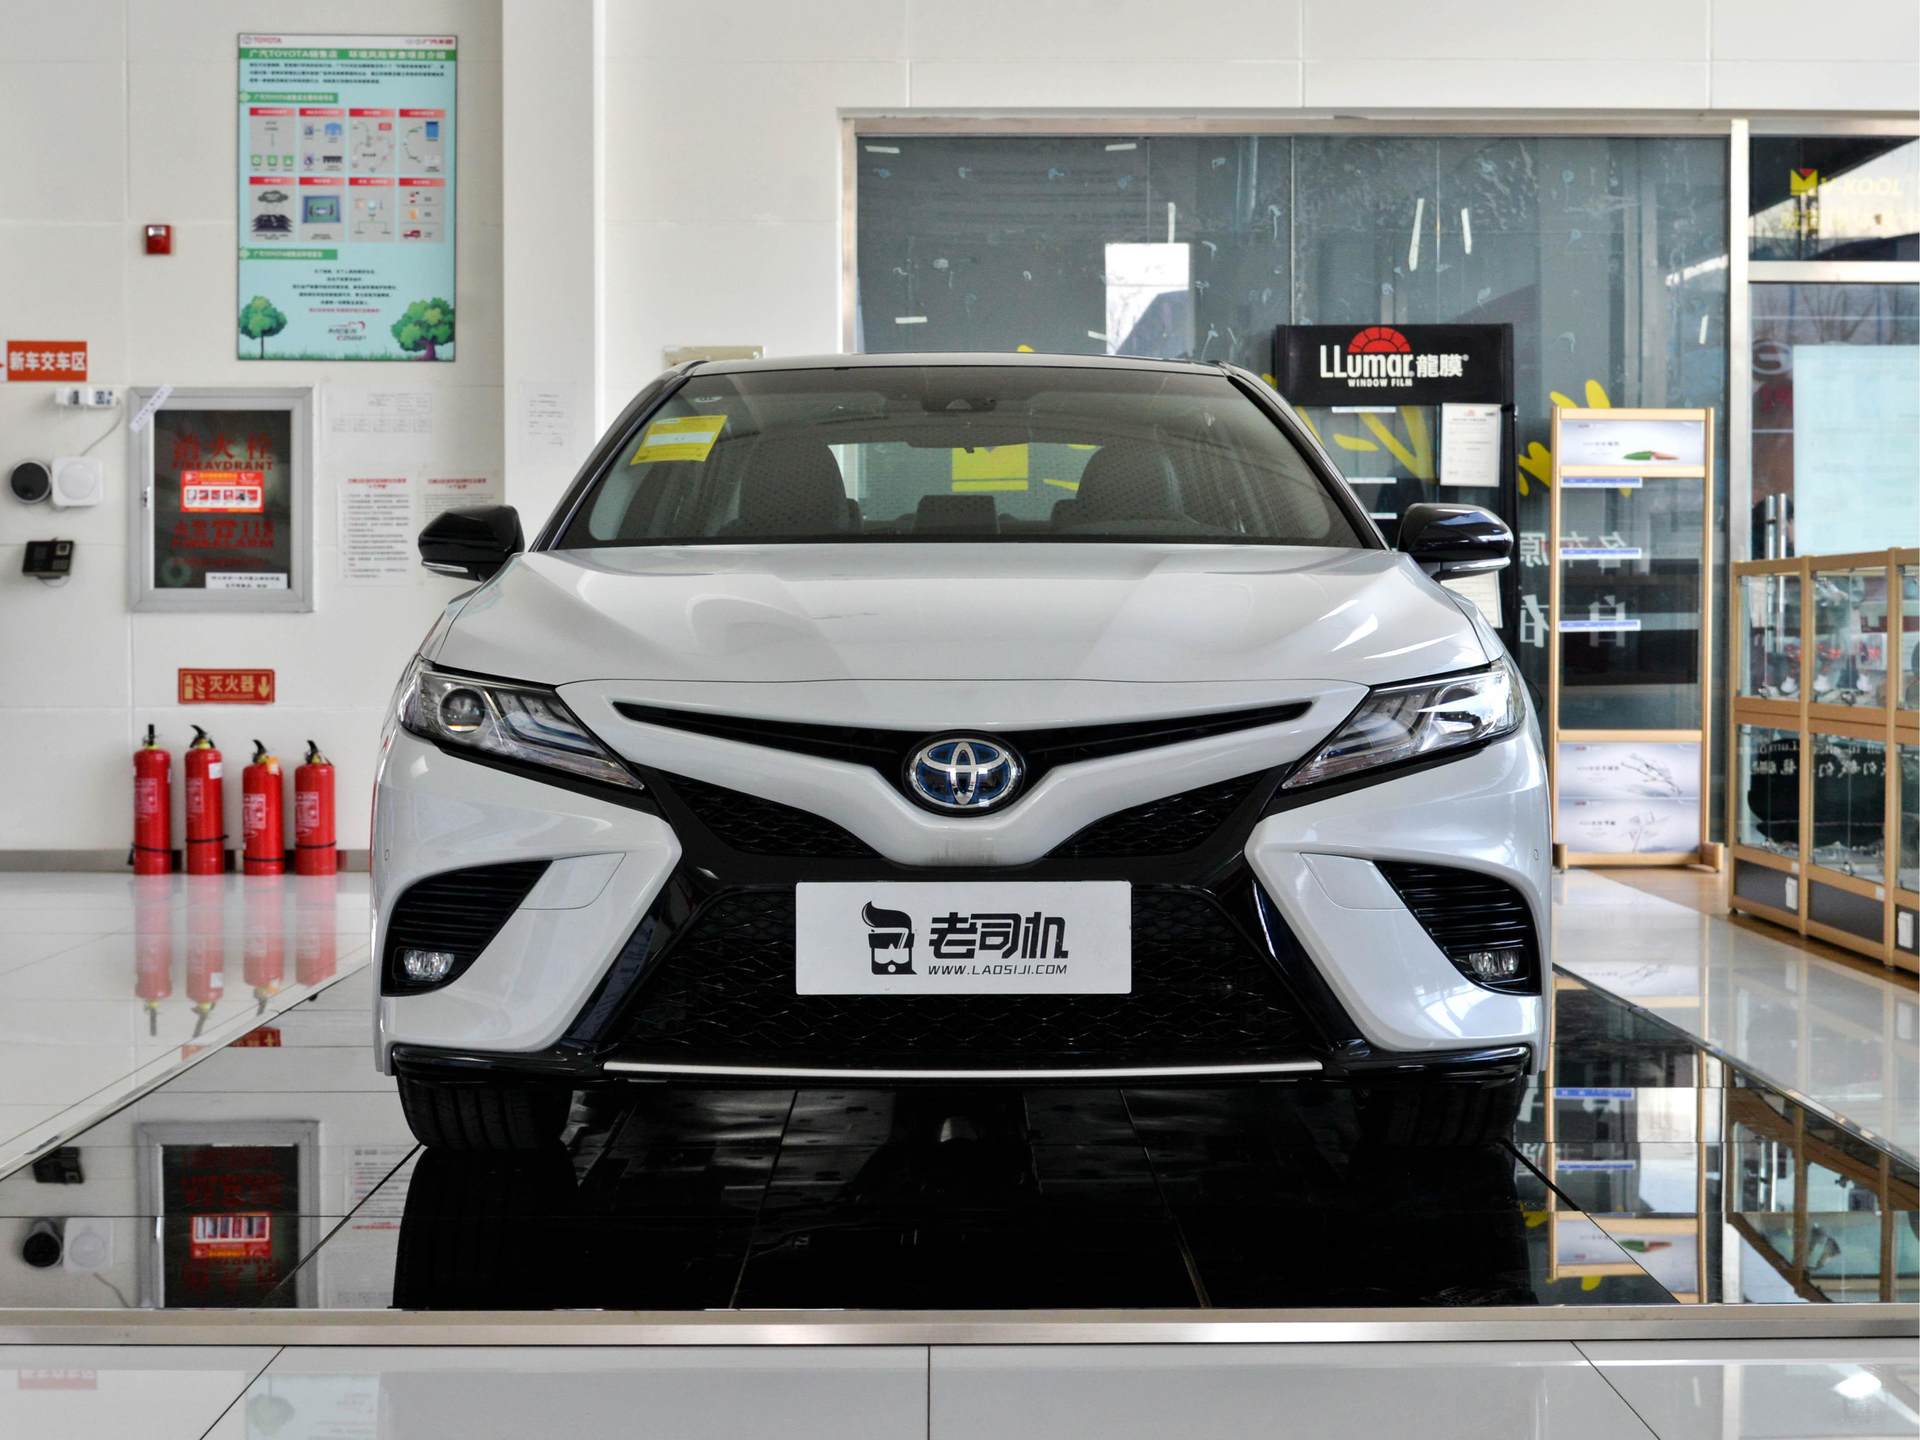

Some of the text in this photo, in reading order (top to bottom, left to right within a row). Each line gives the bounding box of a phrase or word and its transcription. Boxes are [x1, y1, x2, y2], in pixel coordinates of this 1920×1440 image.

[10, 351, 86, 371] 新车交车区
[1320, 345, 1412, 378] LLumar
[1348, 379, 1413, 387] WINDOW FILM
[209, 675, 254, 692] 灭火器
[928, 912, 1069, 959] 老司机
[928, 964, 1067, 976] WWW.LAOSIJI.COM
